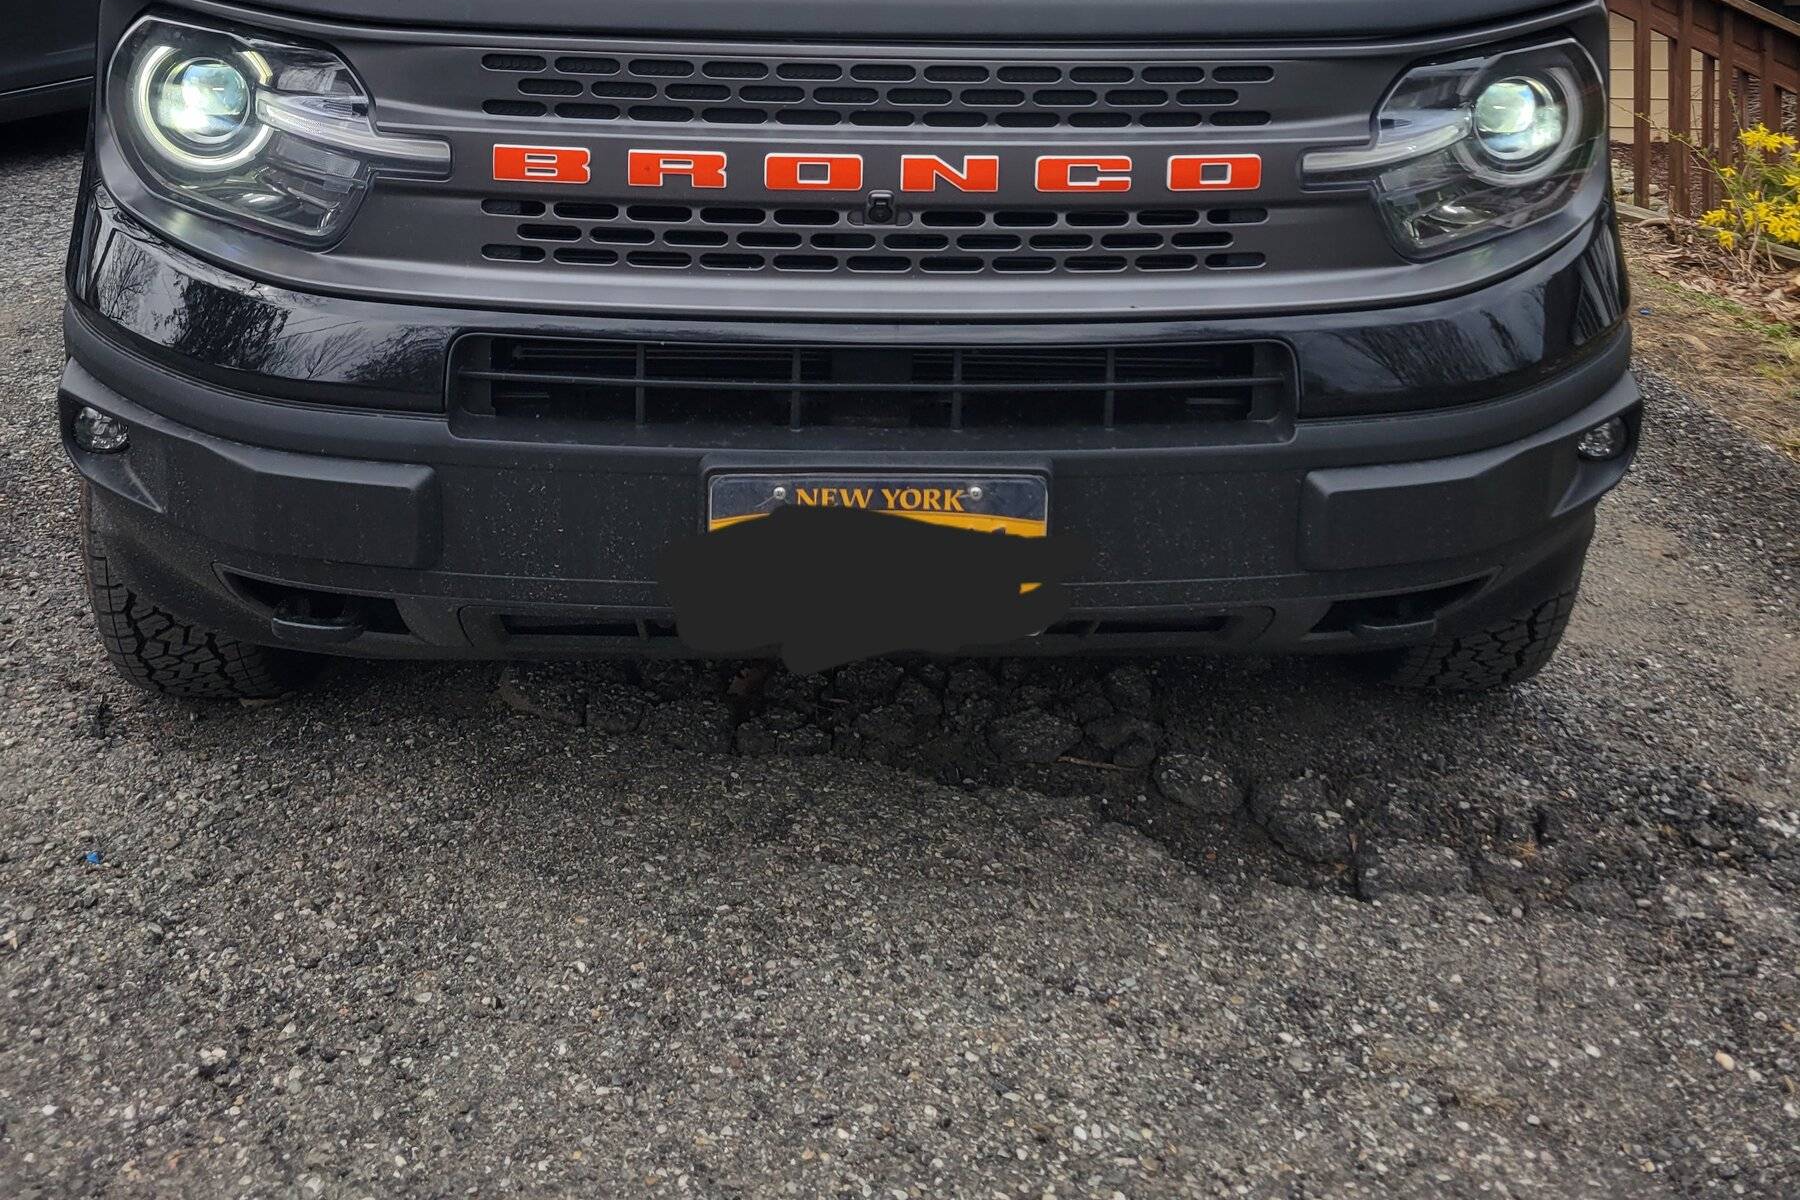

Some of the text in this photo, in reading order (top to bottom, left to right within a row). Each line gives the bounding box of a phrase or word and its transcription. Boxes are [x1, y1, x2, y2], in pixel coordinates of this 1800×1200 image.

[493, 143, 1262, 193] BRONCO
[796, 487, 966, 512] NEW YORK
